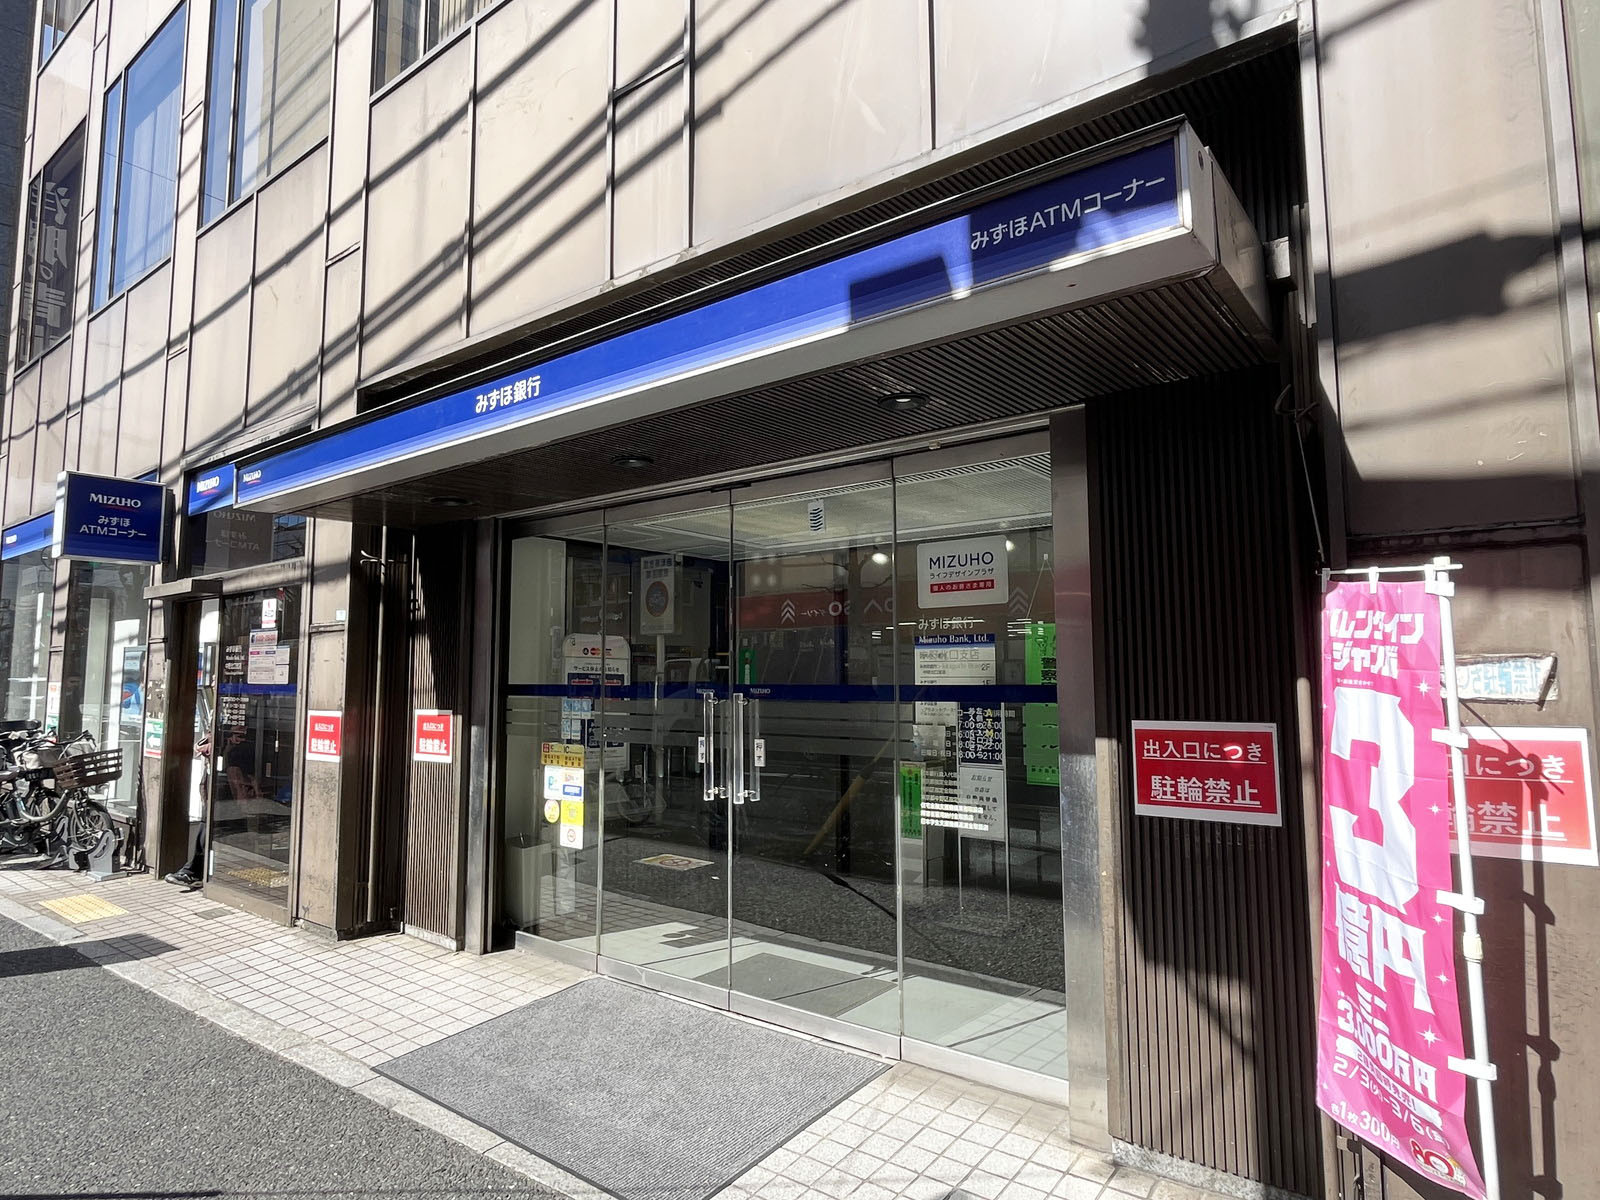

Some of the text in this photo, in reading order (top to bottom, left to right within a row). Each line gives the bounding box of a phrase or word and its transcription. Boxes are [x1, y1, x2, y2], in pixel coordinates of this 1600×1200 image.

[970, 177, 1166, 250] みずほATMコーナー
[475, 375, 541, 414] みずほ銀行
[196, 476, 220, 493] MIZUHO
[89, 492, 141, 509] MIZUHO
[79, 525, 147, 538] ATMコーナー
[97, 515, 131, 527] みずほ
[929, 551, 994, 570] MIZUHO
[929, 567, 995, 580] ライフデザインプラザ
[918, 616, 975, 630] みずほ銀行
[973, 633, 989, 643] Ltd.
[1332, 640, 1399, 680] ジャンボ
[1143, 738, 1262, 762] 出入口につき
[1151, 775, 1261, 805] 駐輪禁止
[1329, 687, 1419, 915] 3
[1335, 881, 1435, 1015] 億円
[1336, 998, 1439, 1104] 3,000万円
[1330, 1099, 1401, 1151] 各1枚300円
